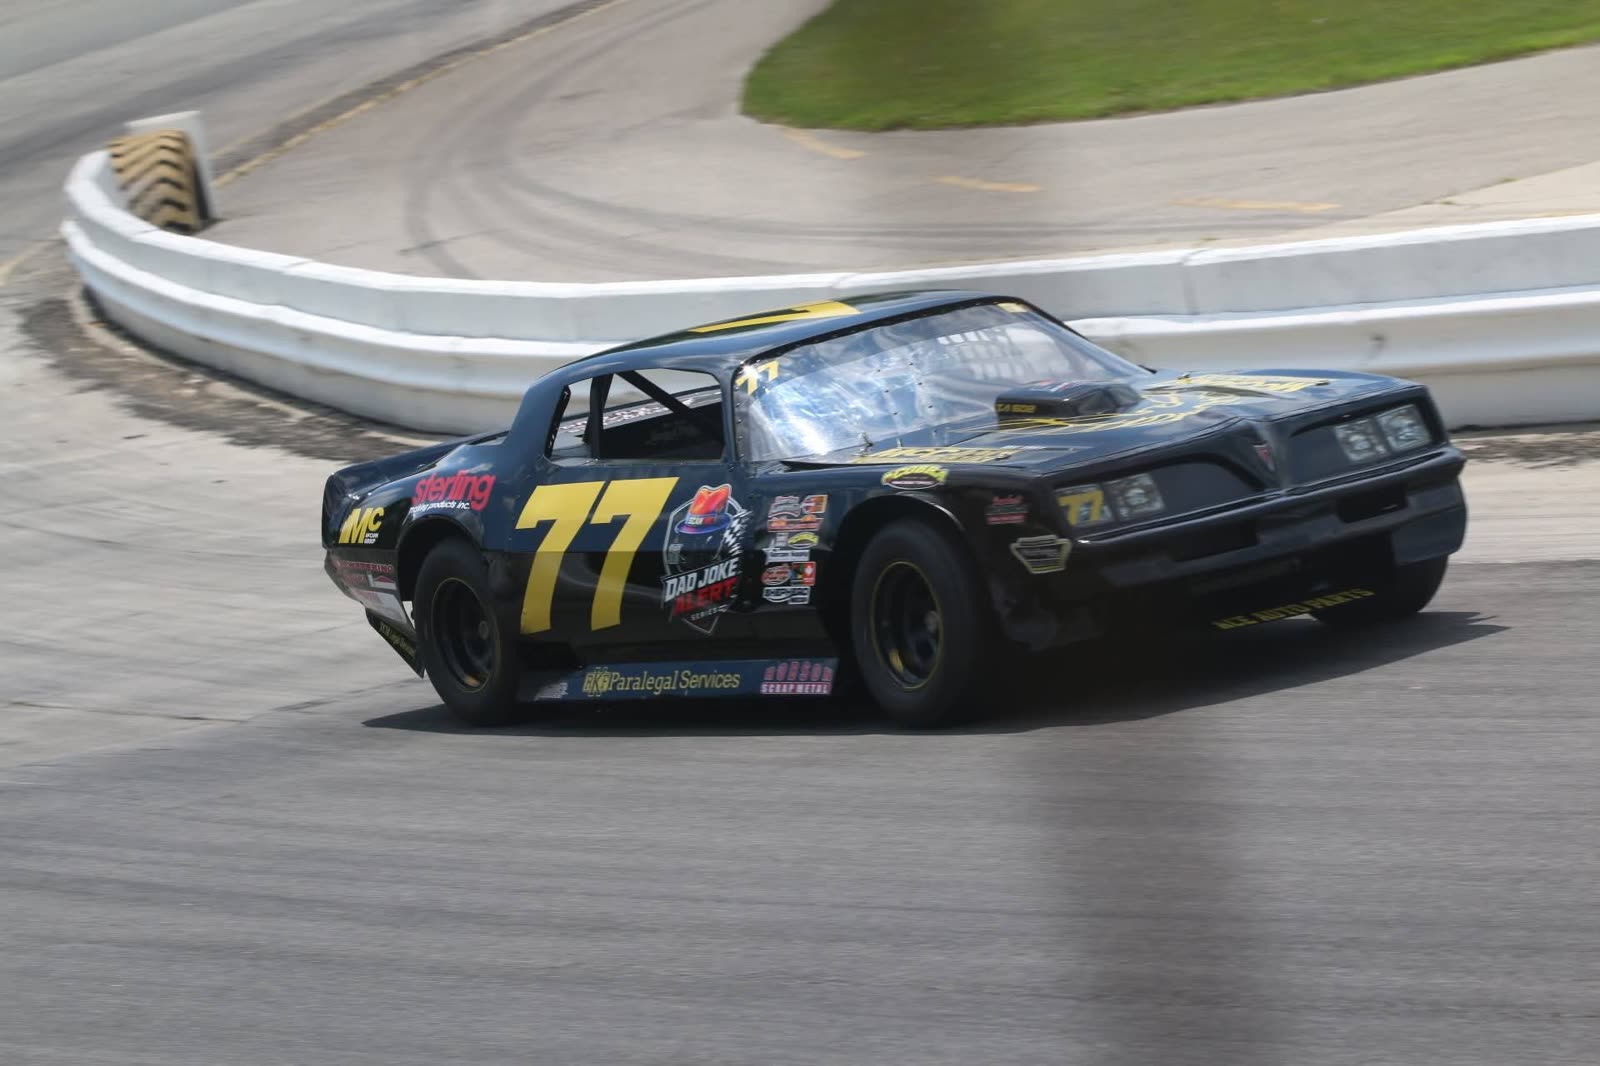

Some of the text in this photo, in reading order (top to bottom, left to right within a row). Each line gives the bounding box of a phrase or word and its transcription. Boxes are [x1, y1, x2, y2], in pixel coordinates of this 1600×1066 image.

[412, 469, 496, 511] sterling
[457, 500, 471, 510] inc.
[1057, 490, 1105, 526] 77
[515, 476, 680, 635] 77
[664, 572, 698, 602] DAD
[698, 557, 740, 588] JOKE
[672, 576, 738, 617] ALERT
[608, 671, 679, 695] Paralegal
[679, 670, 741, 689] Services
[761, 683, 830, 694] SCRAP METAL
